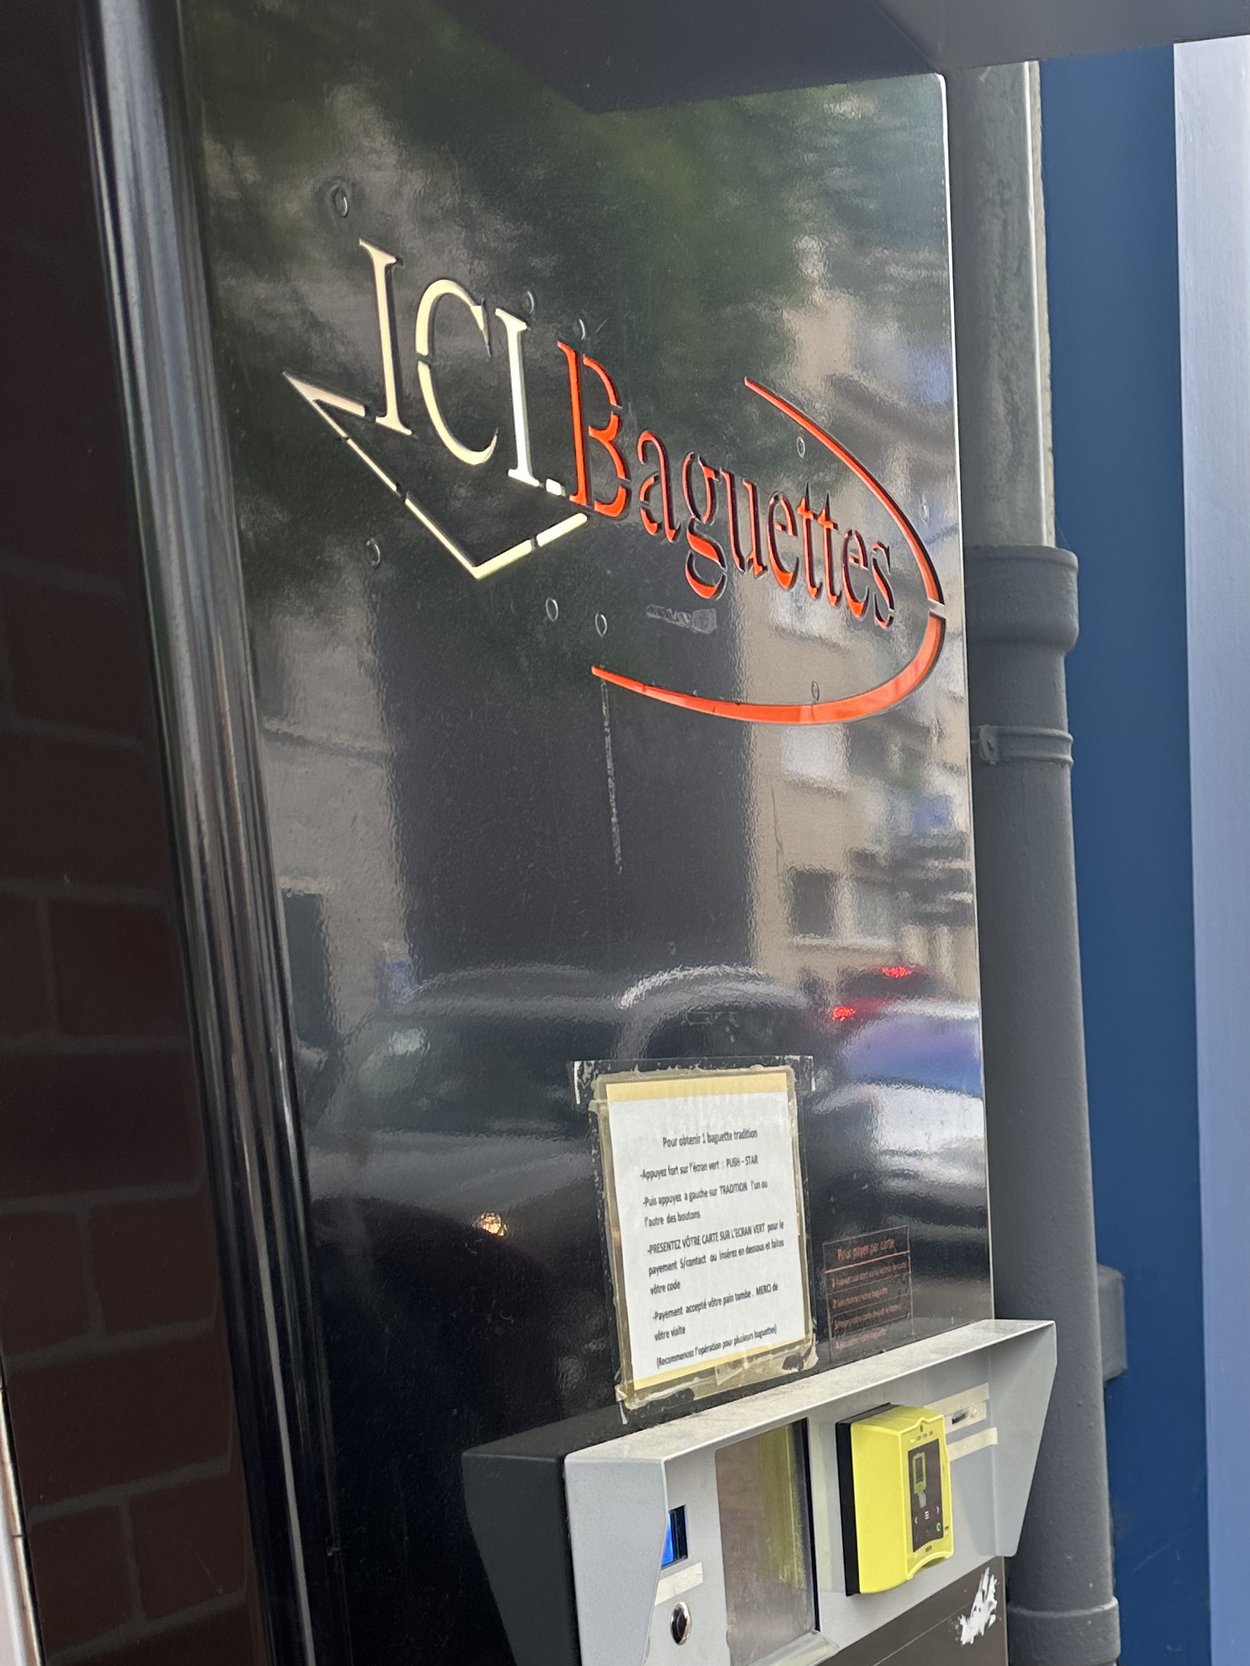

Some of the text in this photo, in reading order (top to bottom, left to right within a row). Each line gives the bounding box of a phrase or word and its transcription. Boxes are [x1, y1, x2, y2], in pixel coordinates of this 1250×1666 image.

[557, 340, 896, 629] Baguettes
[663, 1128, 758, 1148] Pour obtenir 1 baguette tradition
[668, 1165, 679, 1176] fort
[680, 1166, 688, 1175] sur
[709, 1160, 719, 1171] vert
[726, 1157, 740, 1168] PUSH
[745, 1154, 758, 1166] STAR
[658, 1194, 682, 1207] appuyez
[689, 1188, 708, 1203] gauche
[709, 1188, 717, 1197] sur
[719, 1182, 748, 1195] TRADITION
[666, 1213, 677, 1224] des
[677, 1211, 701, 1222] boutons
[702, 1232, 719, 1244] CARTE
[720, 1230, 730, 1241] SUR
[753, 1223, 765, 1234] VERT
[767, 1223, 778, 1233] pour
[779, 1220, 784, 1229] le
[648, 1260, 678, 1277] payement
[710, 1254, 717, 1262] ou
[738, 1248, 745, 1256] en
[745, 1244, 765, 1254] dessous
[765, 1241, 771, 1250] et
[771, 1239, 784, 1249] faites
[667, 1280, 681, 1292] code
[686, 1298, 707, 1314] accepté
[723, 1293, 734, 1306] pain
[735, 1289, 751, 1301] tombe
[756, 1284, 771, 1295] MERCI
[772, 1282, 778, 1292] de
[670, 1325, 686, 1337] visite
[722, 1339, 733, 1350] pour
[734, 1333, 754, 1347] plusieurs
